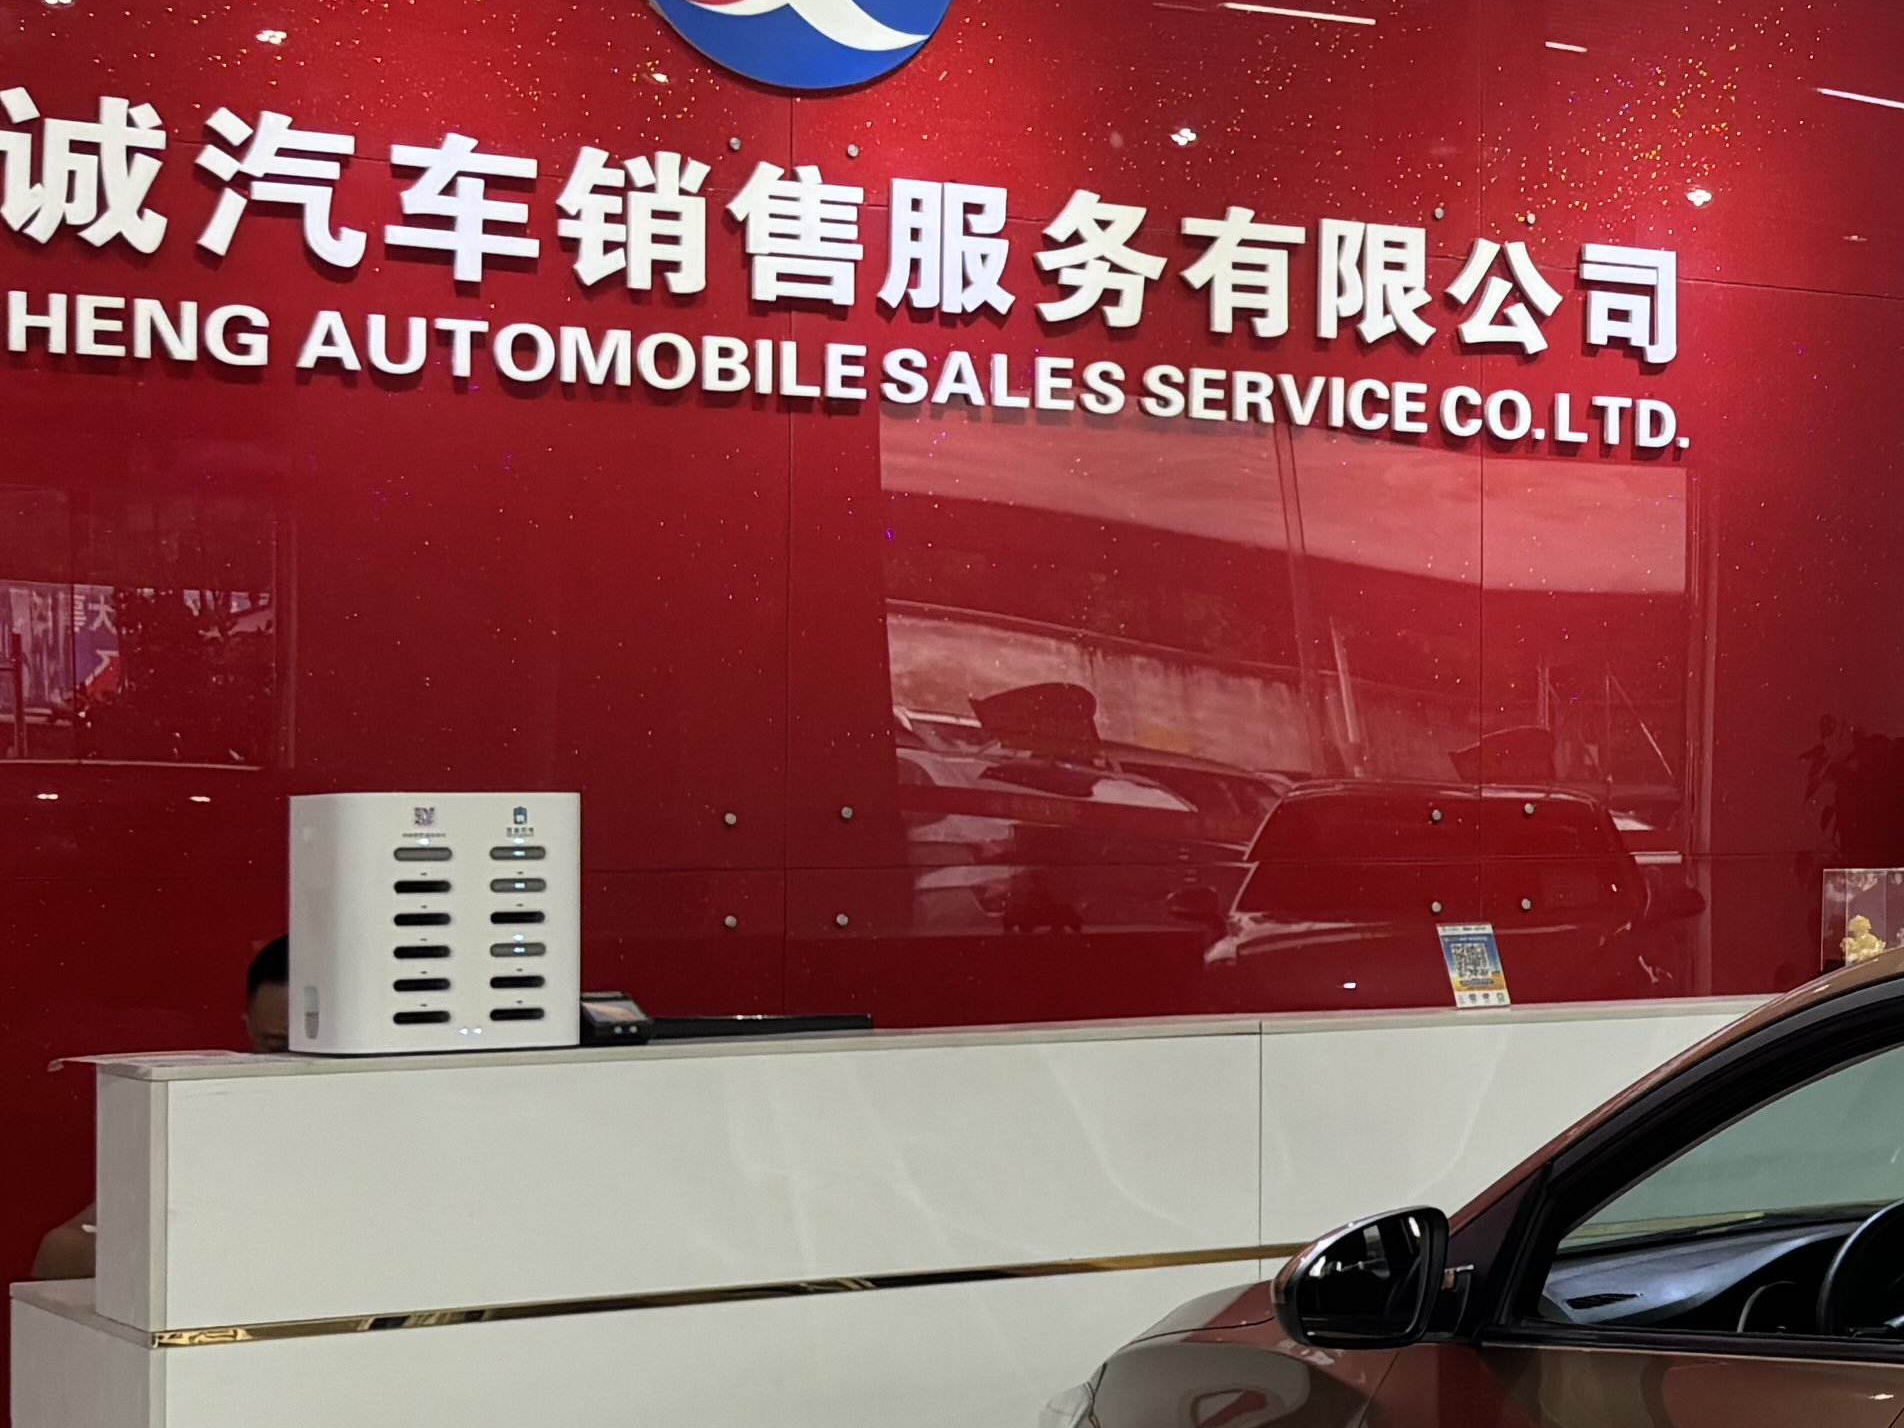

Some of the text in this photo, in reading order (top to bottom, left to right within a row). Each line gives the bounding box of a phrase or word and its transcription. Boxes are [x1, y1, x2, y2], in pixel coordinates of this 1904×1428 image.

[0, 86, 1680, 367] 诚汽车销售服务有限公司
[8, 289, 270, 368] HENG
[296, 309, 869, 402] AUTOMOBILE
[880, 345, 1124, 416] SALES
[1138, 361, 1428, 436] SERVICE
